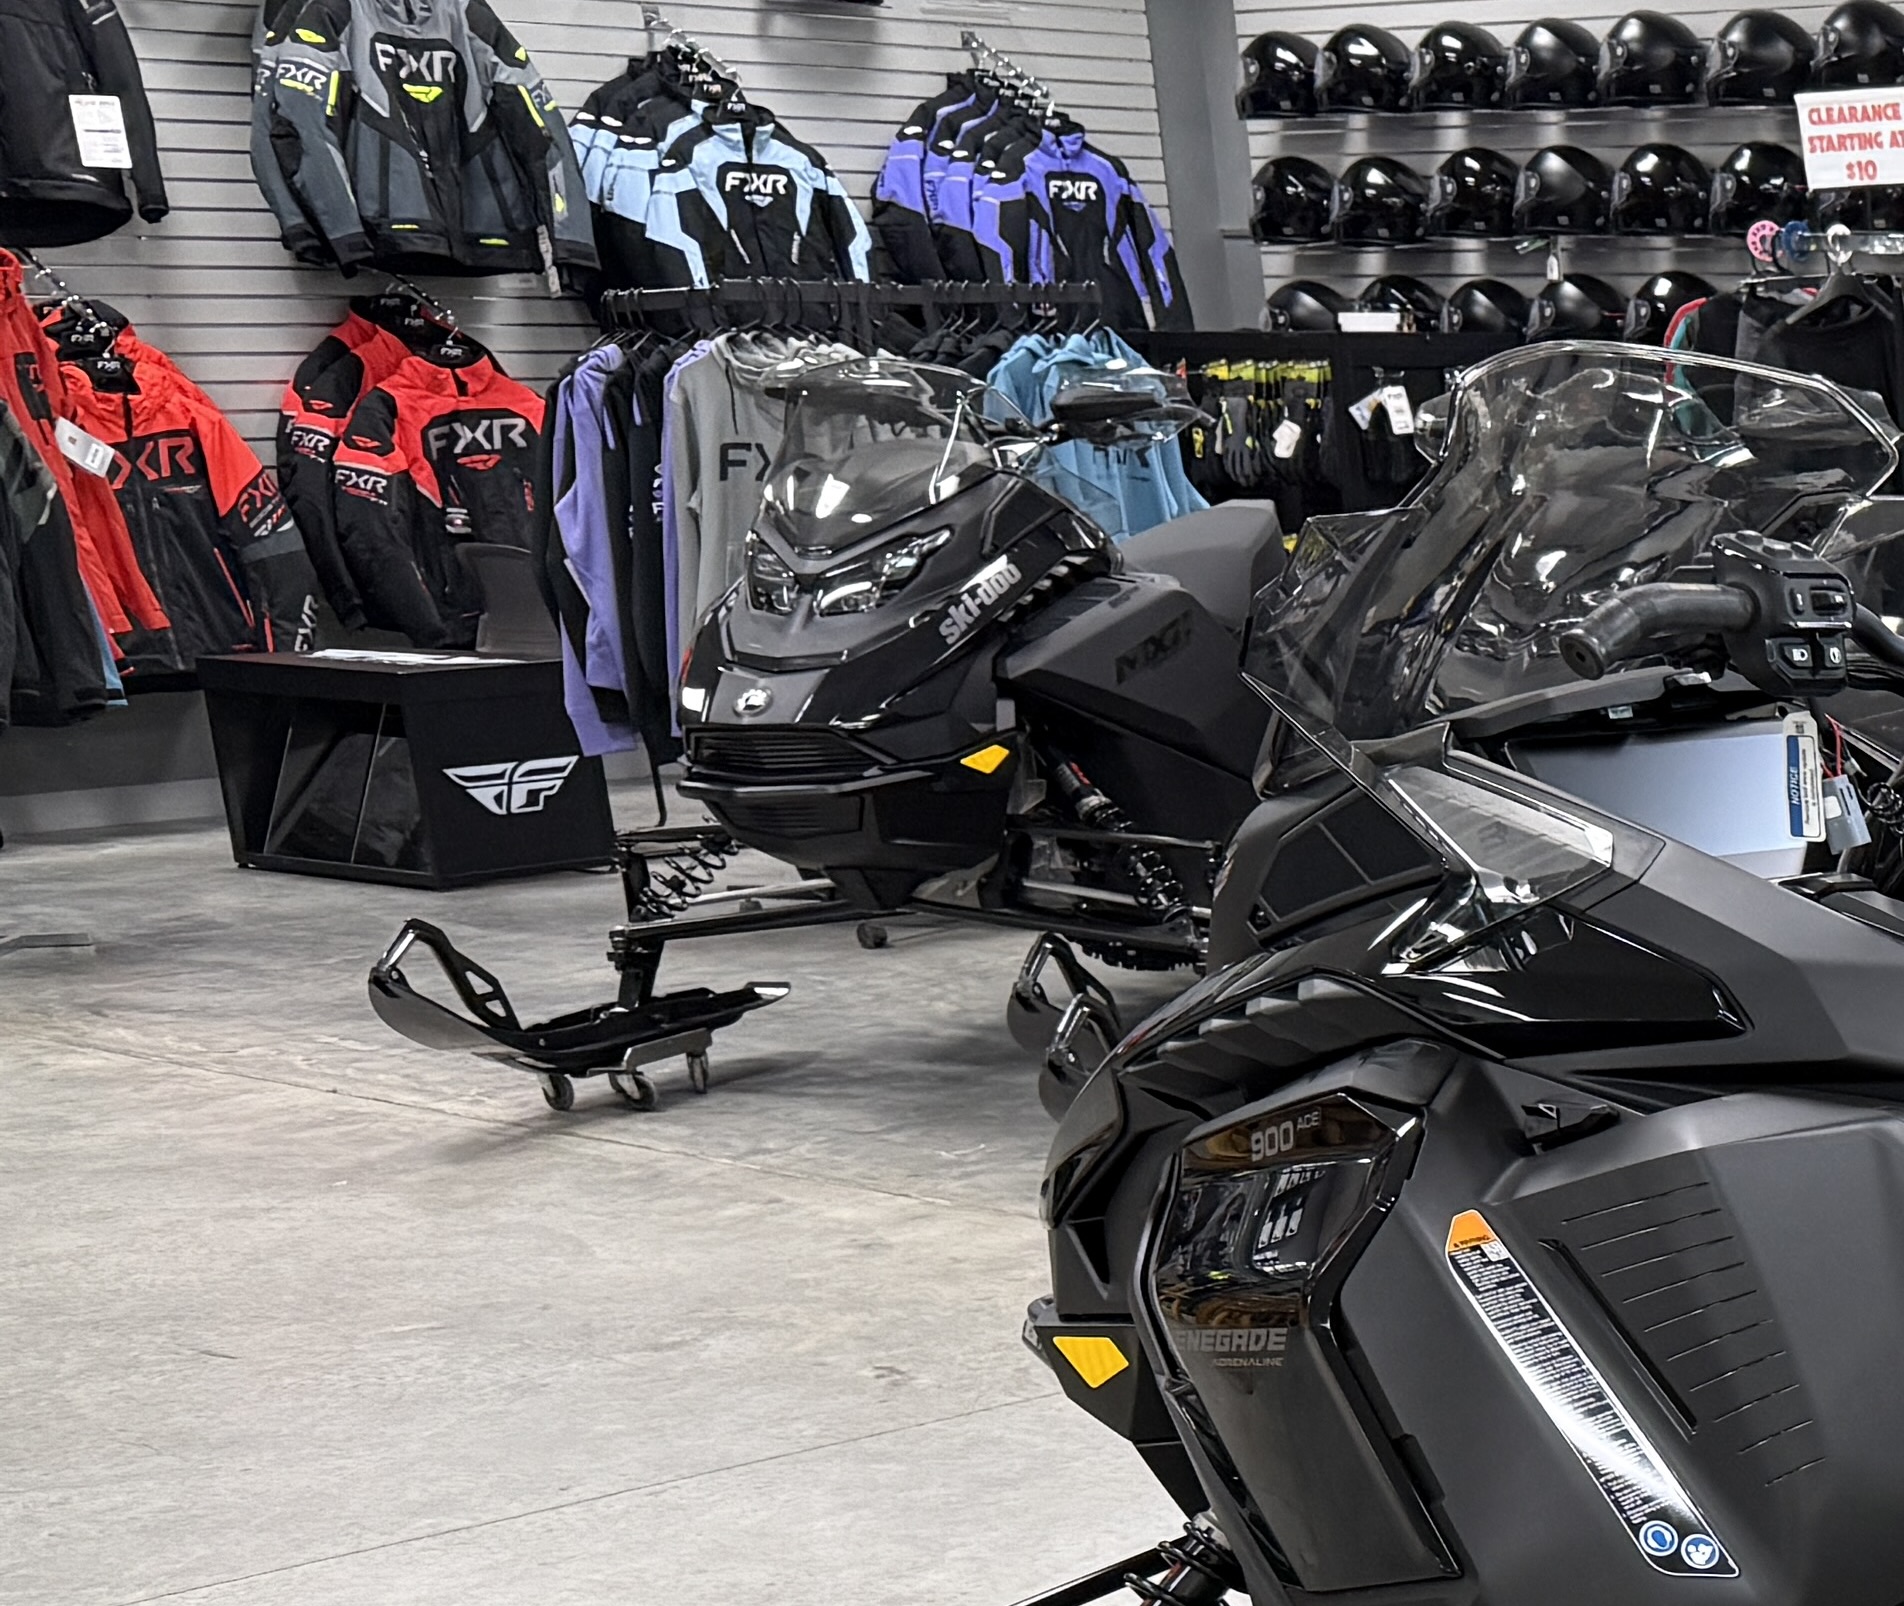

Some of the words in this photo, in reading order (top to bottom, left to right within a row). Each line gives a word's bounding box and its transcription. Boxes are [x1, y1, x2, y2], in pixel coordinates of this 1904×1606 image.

[374, 41, 458, 84] FXR
[275, 63, 328, 91] FXR
[1808, 102, 1902, 126] CLEARANCE
[1807, 131, 1884, 154] STARTING
[724, 170, 790, 194] FXR
[1845, 160, 1878, 181] $10
[1048, 179, 1098, 200] FXR
[291, 430, 331, 454] FXR
[428, 417, 528, 461] FXR
[111, 436, 196, 490] XR
[334, 469, 388, 494] FXR
[938, 562, 1023, 646] ski-doo
[295, 594, 319, 653] FXR
[1788, 765, 1801, 806] NOTICE
[1250, 1120, 1295, 1162] 900
[1296, 1110, 1322, 1131] ACE
[1173, 1327, 1288, 1352] ENEGADE
